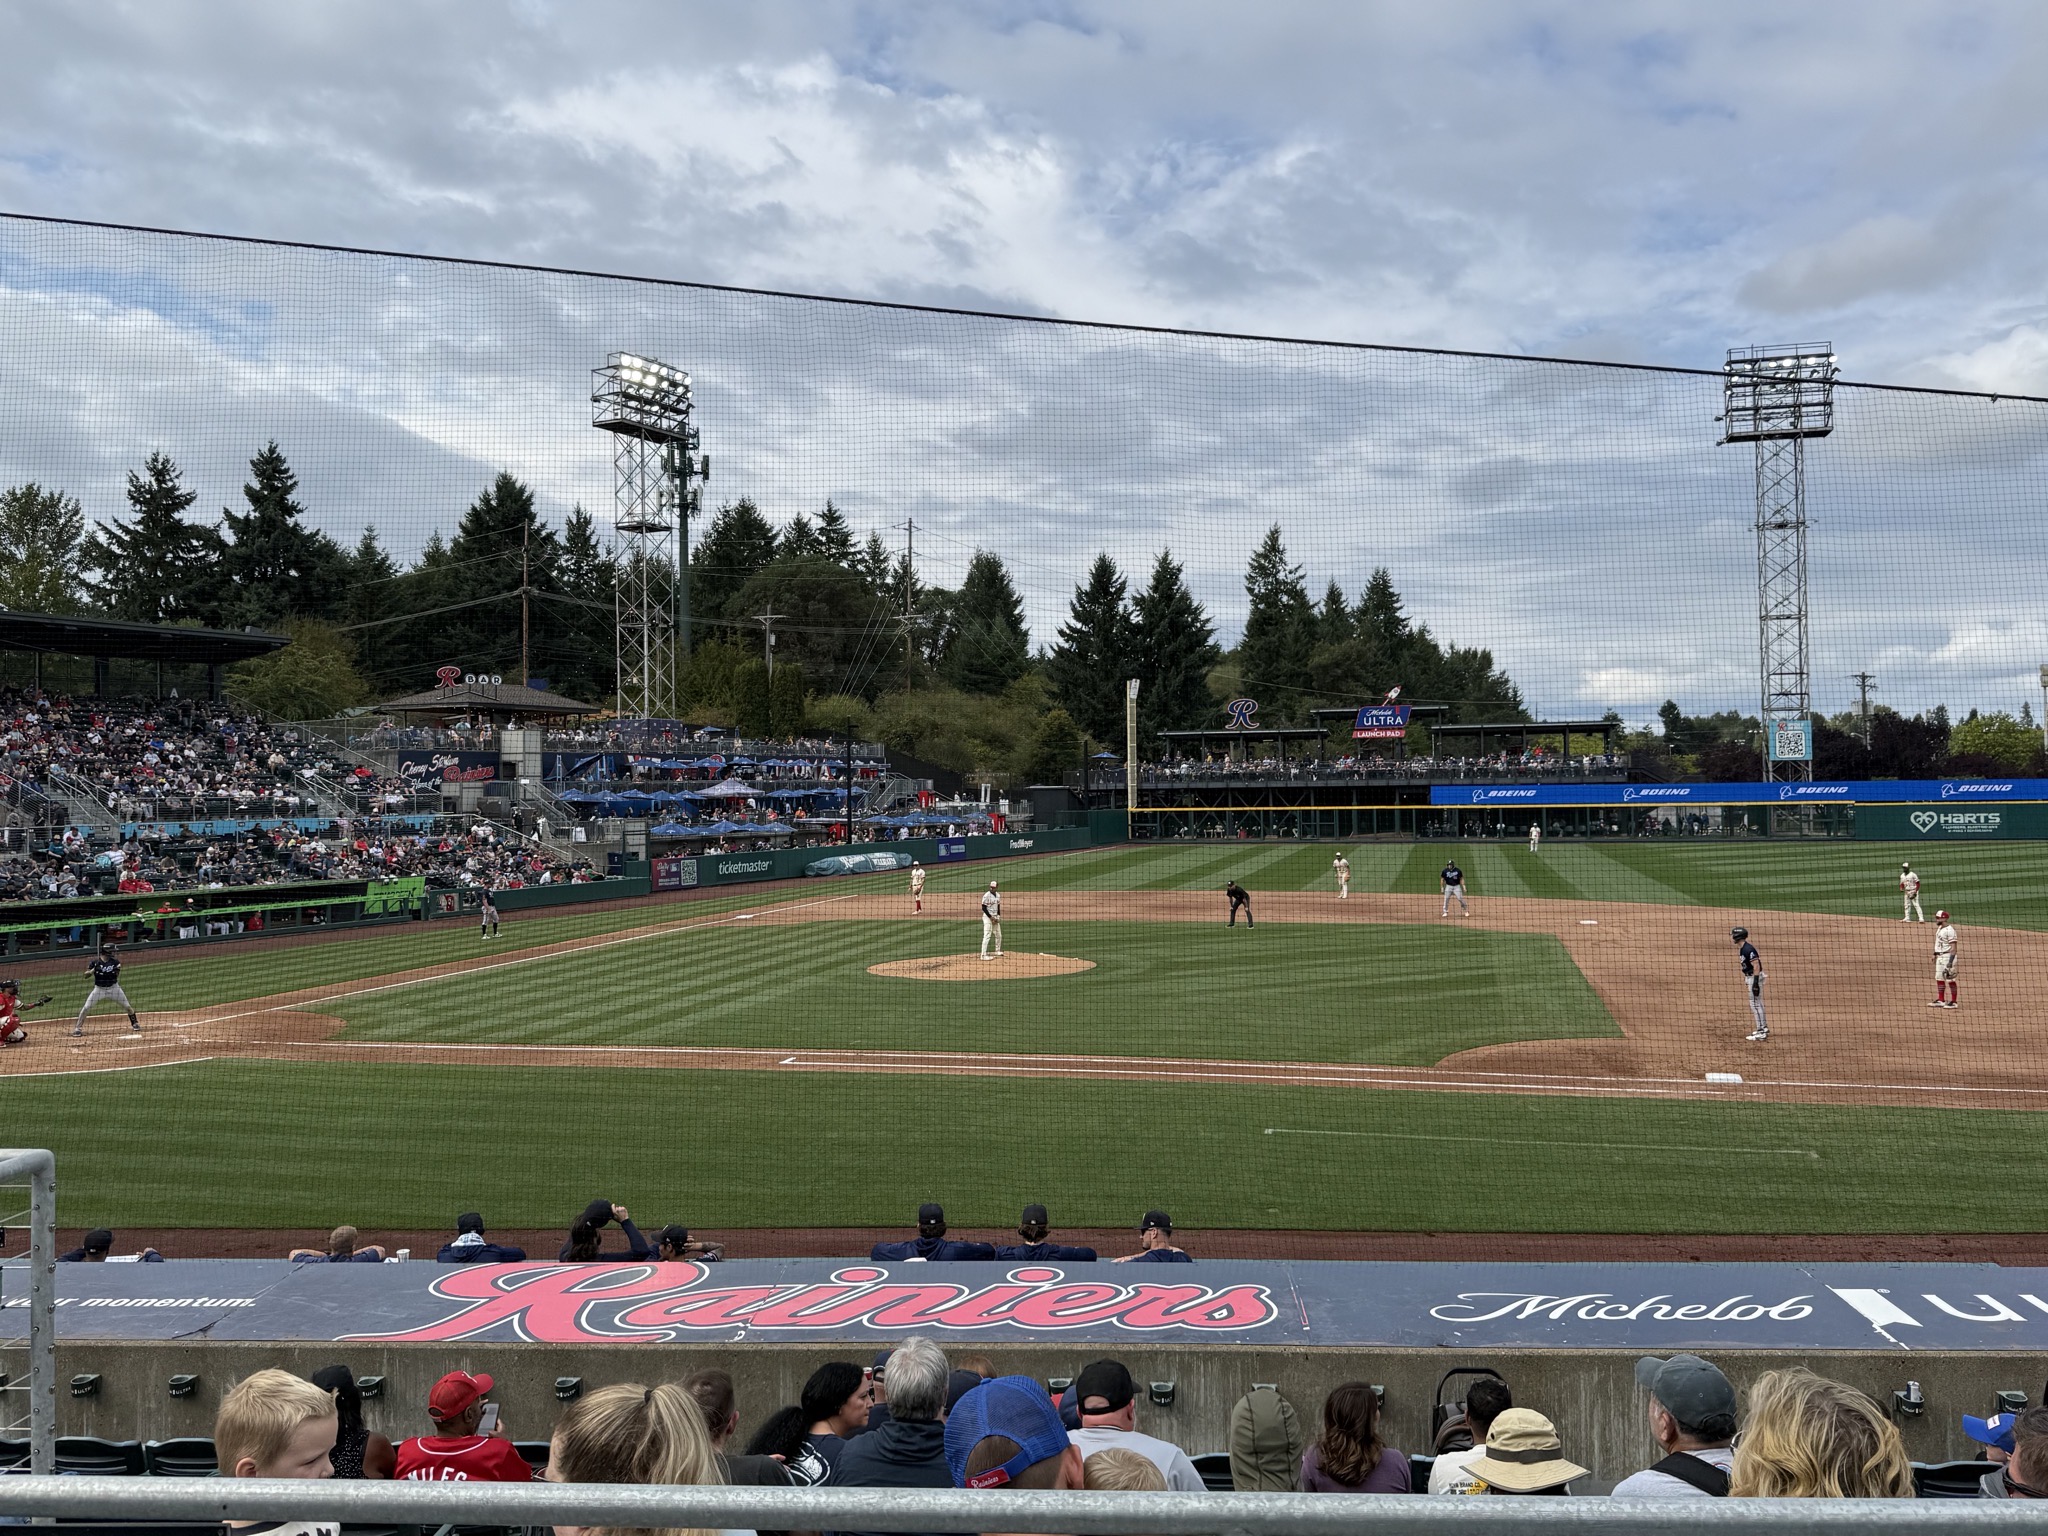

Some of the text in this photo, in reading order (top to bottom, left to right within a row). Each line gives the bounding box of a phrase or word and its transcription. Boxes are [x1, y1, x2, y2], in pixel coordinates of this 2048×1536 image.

[466, 675, 501, 685] BAR
[170, 688, 179, 698] A
[1363, 716, 1403, 725] ULTRA
[1796, 786, 1849, 794] BOEING
[1958, 784, 2013, 792] BOEING
[718, 860, 770, 874] ticketmaster
[79, 1297, 256, 1307] momentum.
[333, 1262, 1278, 1341] Rainiers
[1430, 1293, 1814, 1322] Michelob
